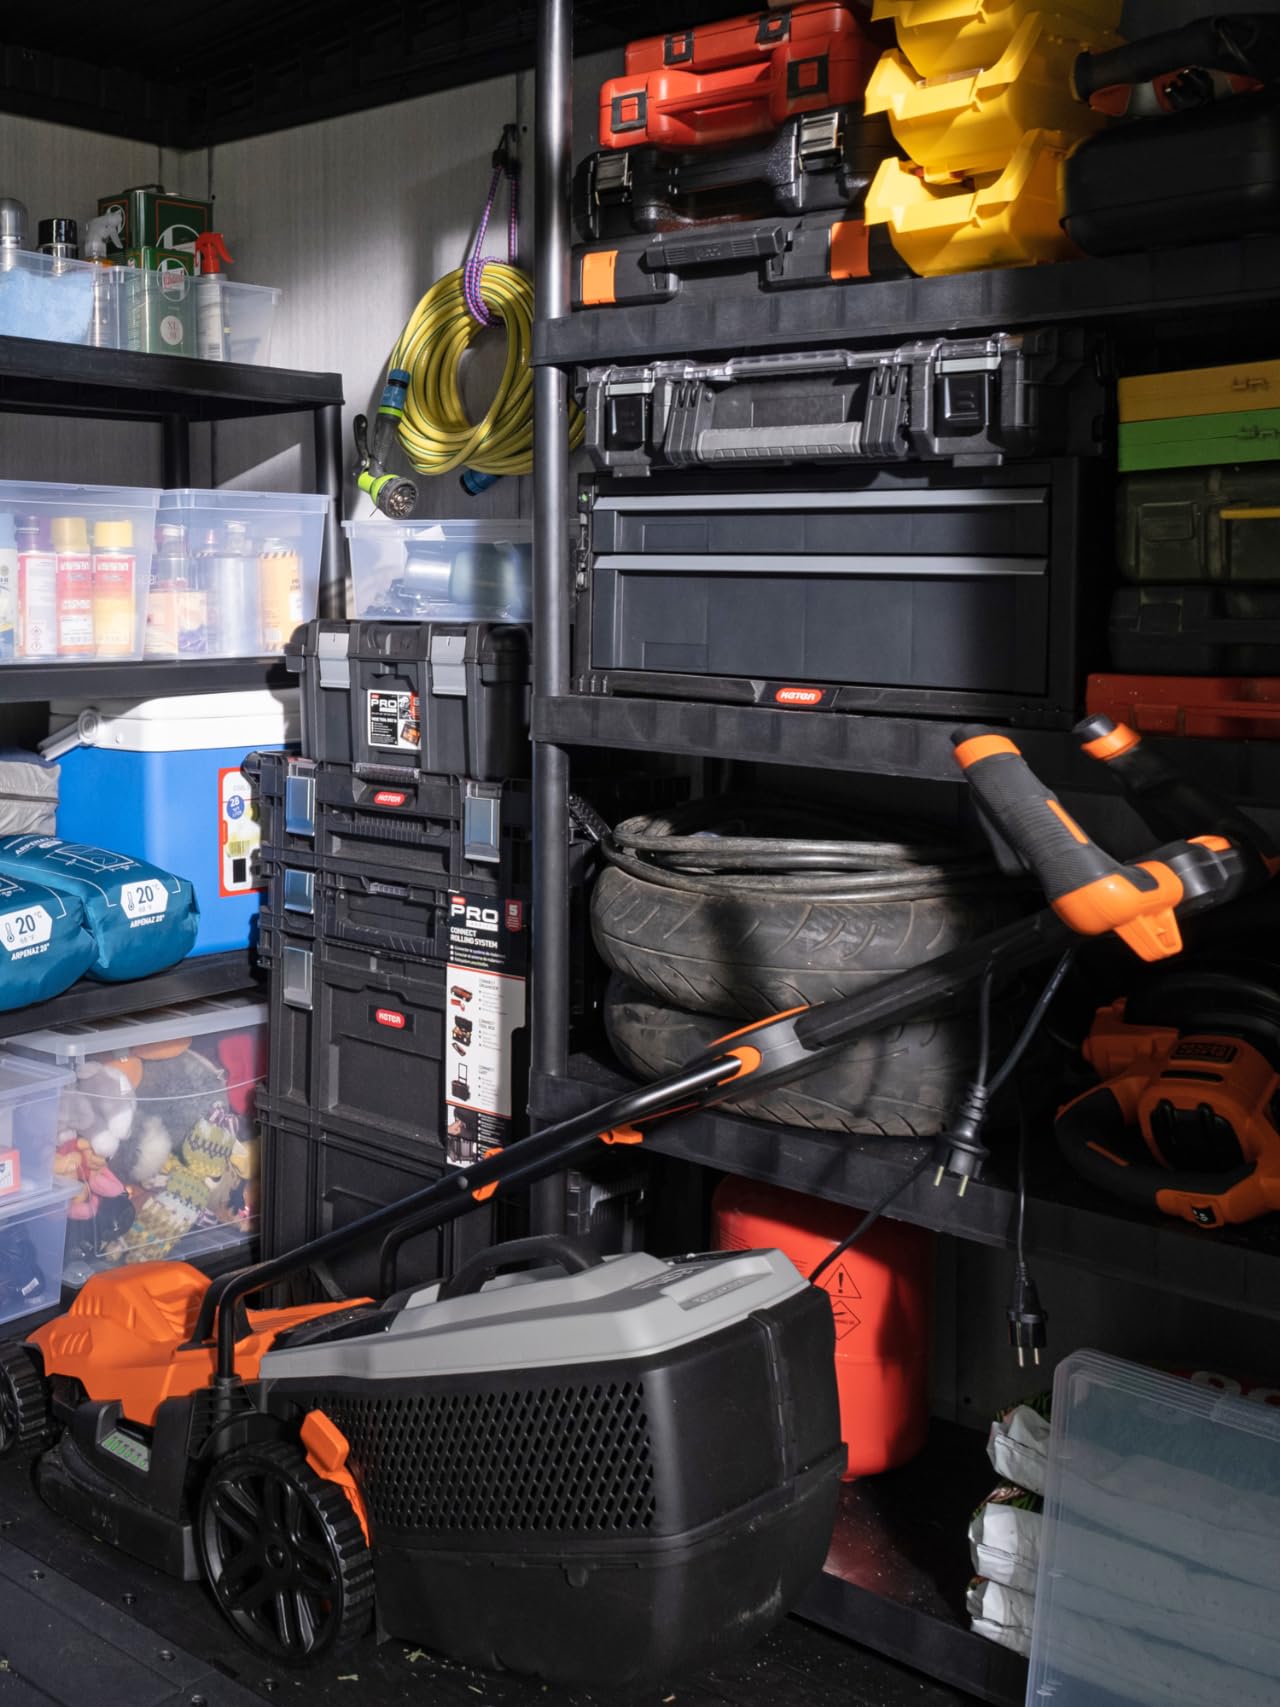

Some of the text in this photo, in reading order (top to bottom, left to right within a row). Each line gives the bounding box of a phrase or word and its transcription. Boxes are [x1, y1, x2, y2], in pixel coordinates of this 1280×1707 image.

[780, 691, 816, 701] KETER
[371, 698, 397, 708] PRO
[135, 885, 154, 904] 20
[451, 903, 499, 924] PRO
[509, 904, 518, 916] 5
[15, 914, 36, 935] 20
[450, 926, 477, 938] CONNECT
[450, 934, 498, 949] ROLLING SYSTEM
[11, 948, 40, 960] ARPENAZ
